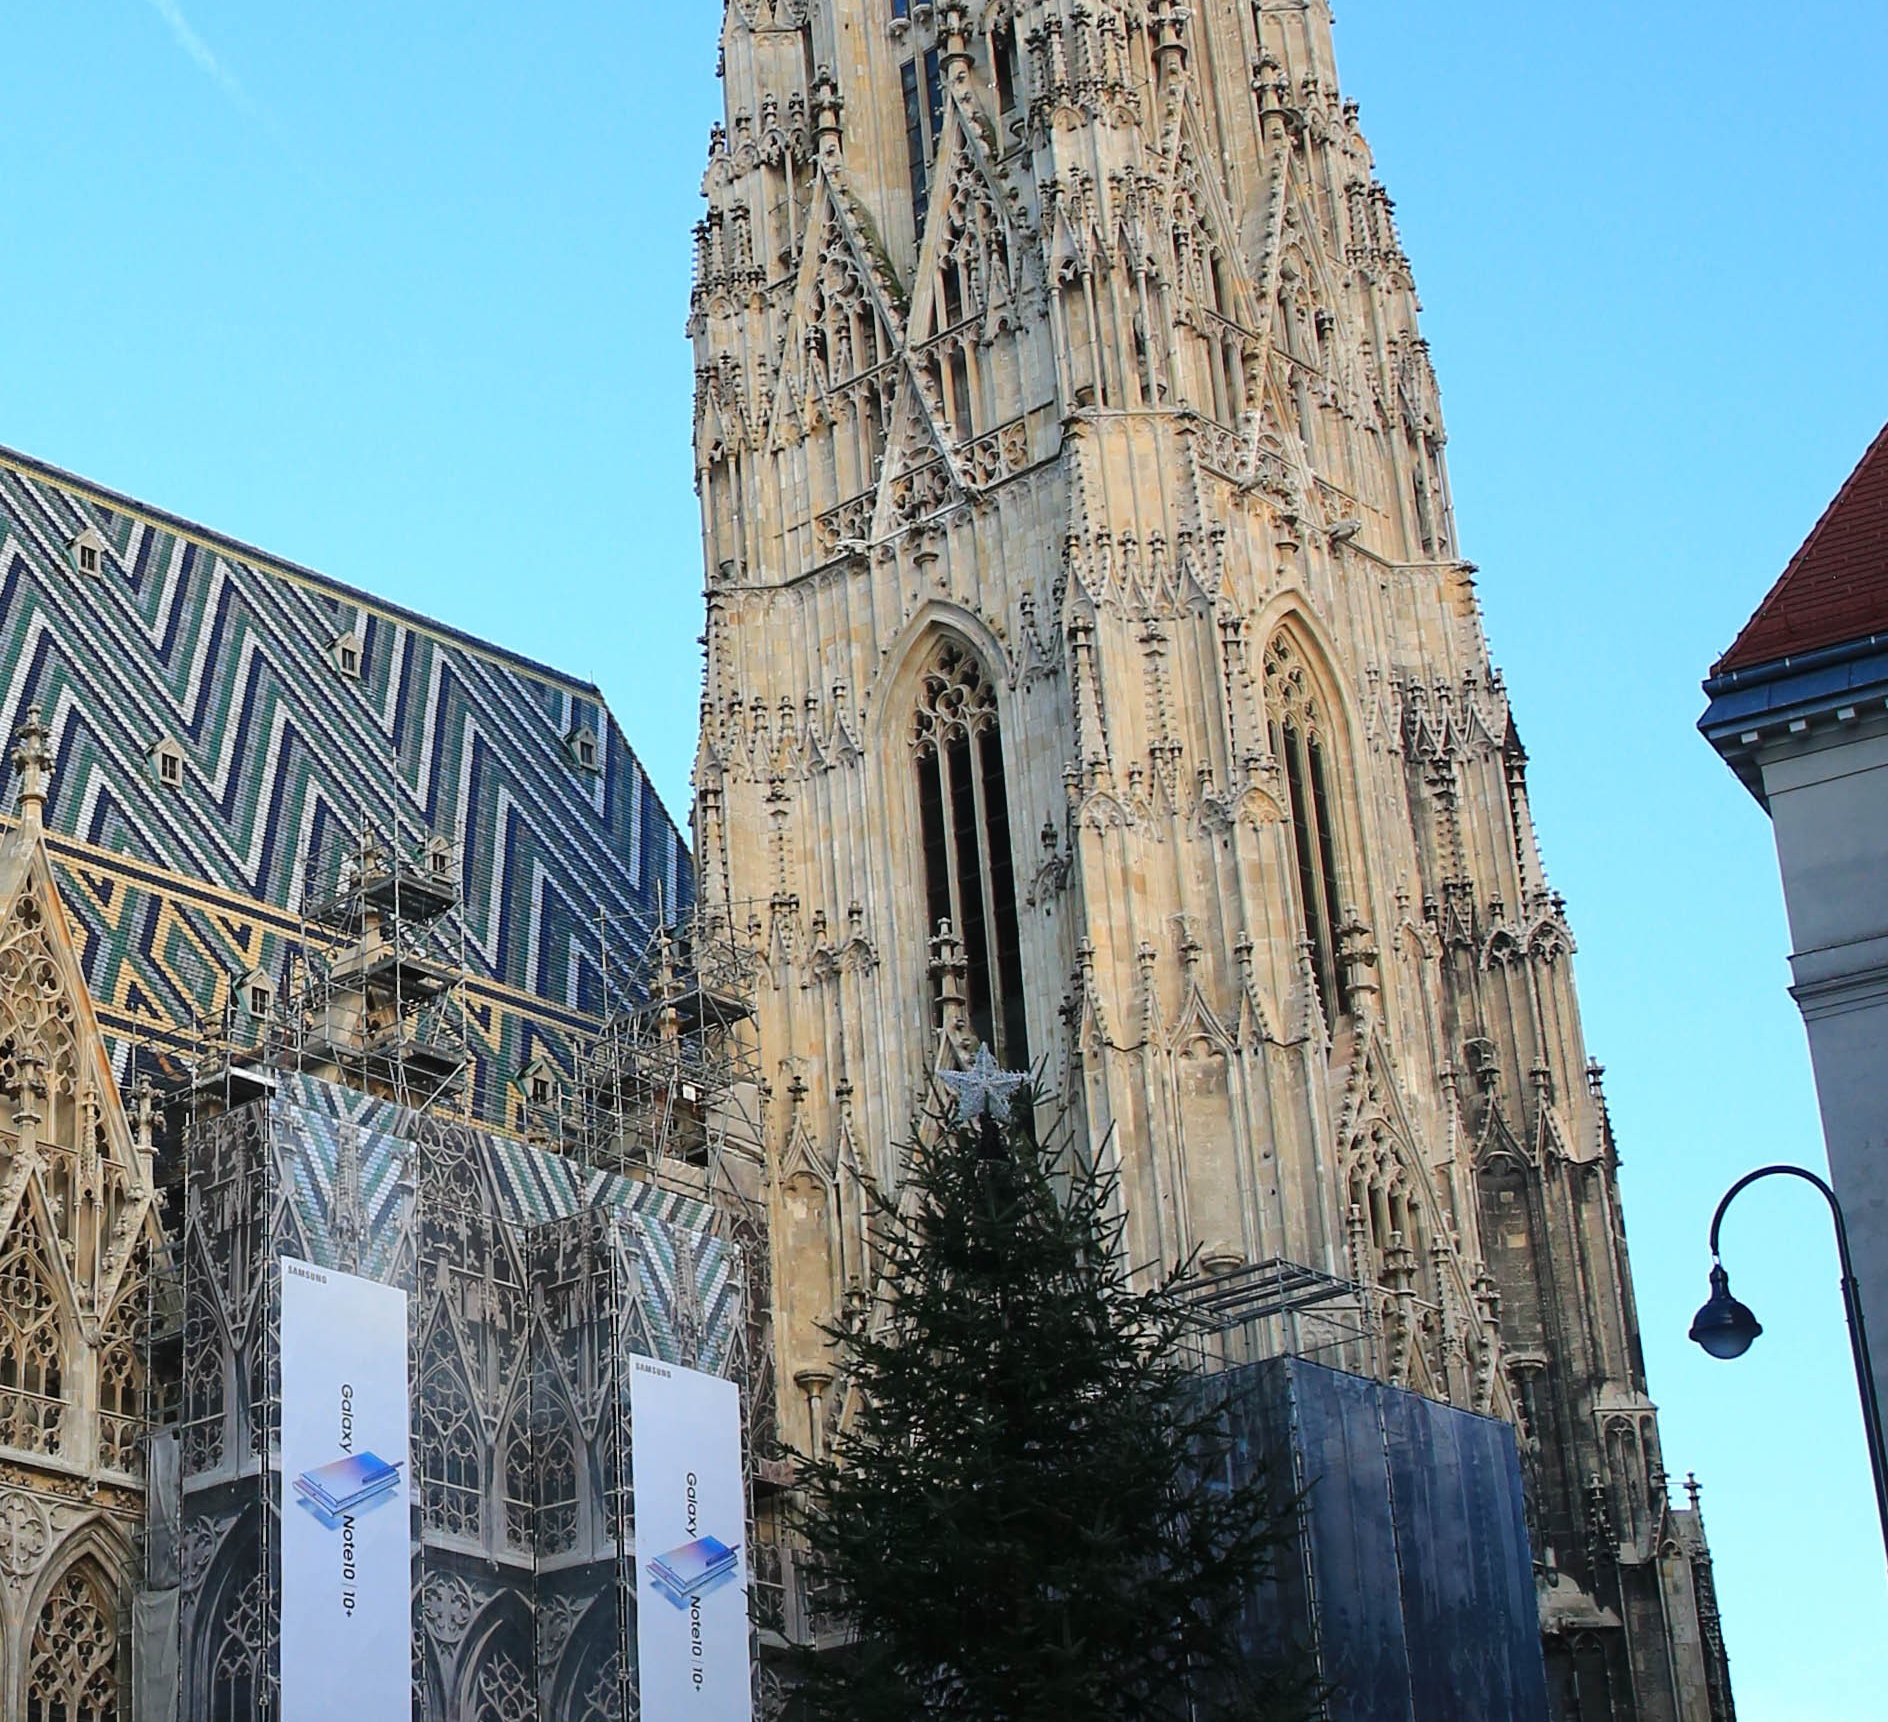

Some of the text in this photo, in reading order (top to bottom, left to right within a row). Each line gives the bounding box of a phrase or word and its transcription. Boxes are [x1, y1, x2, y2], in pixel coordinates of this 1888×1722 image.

[287, 1264, 328, 1284] SAMSUNG
[635, 1361, 672, 1379] SAMSUNG
[339, 1383, 354, 1455] Galaxy
[684, 1471, 698, 1538] Galaxy
[342, 1514, 357, 1581] Note10
[690, 1595, 704, 1657] Note10
